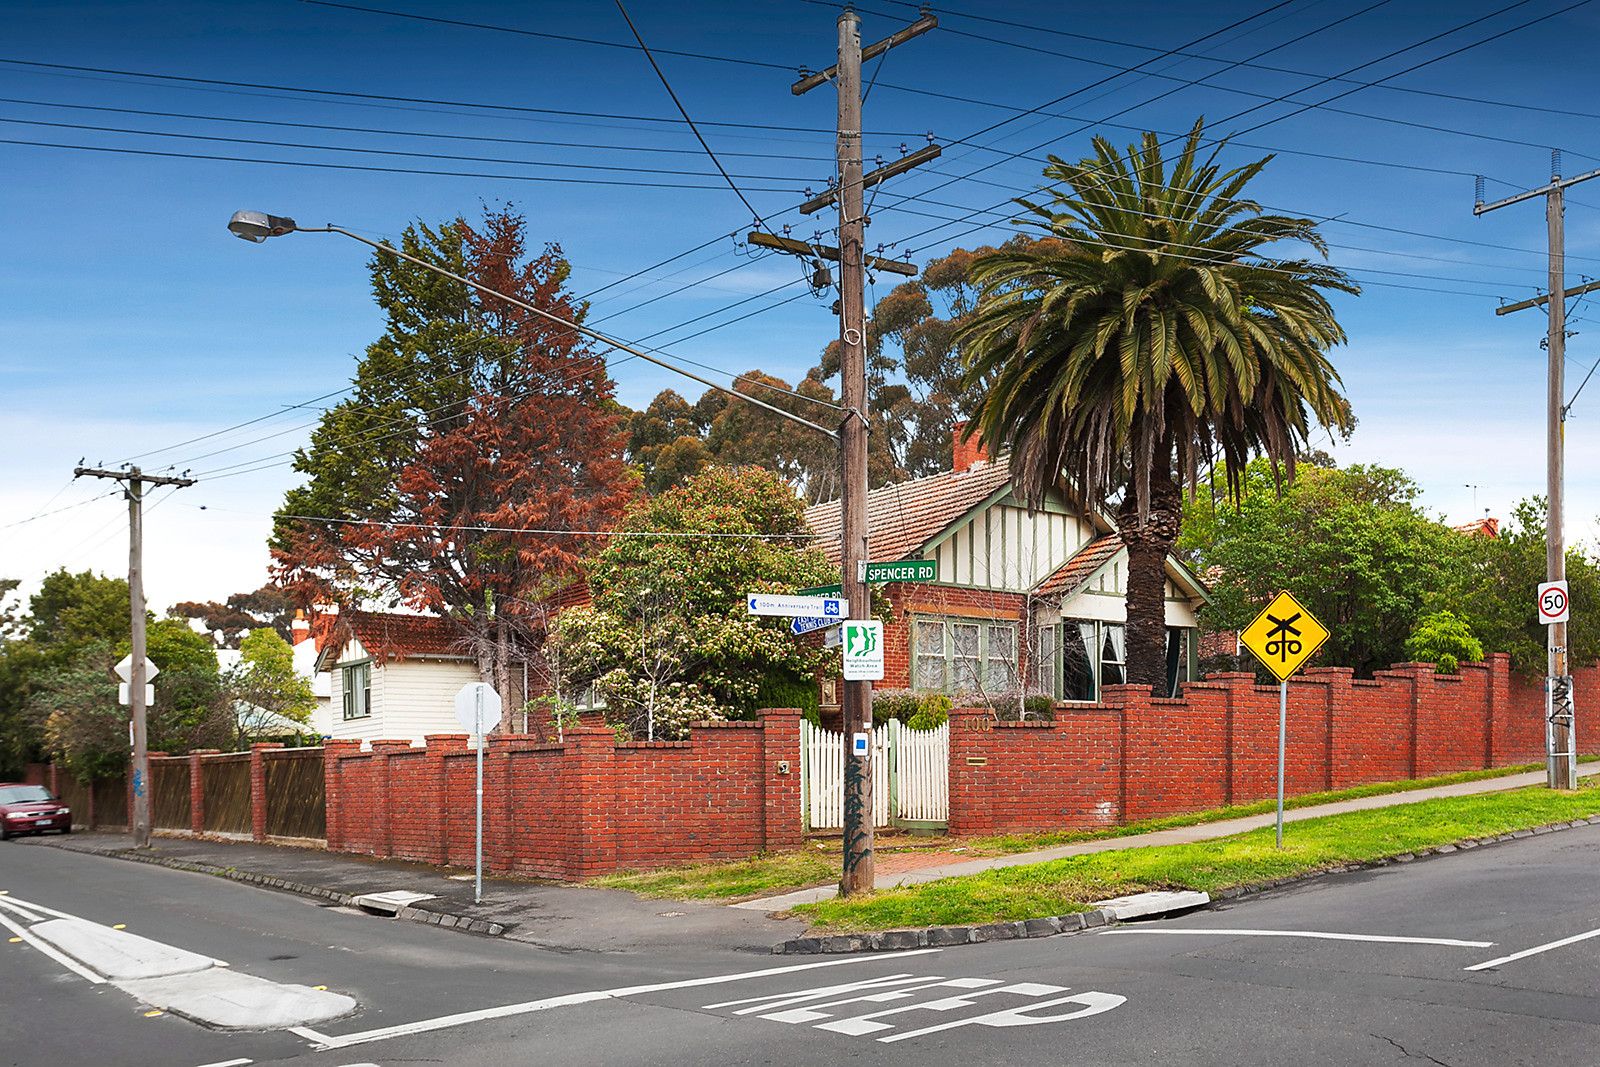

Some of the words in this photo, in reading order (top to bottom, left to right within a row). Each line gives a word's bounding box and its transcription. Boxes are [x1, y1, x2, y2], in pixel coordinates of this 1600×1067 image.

[868, 567, 915, 581] SPENCER
[918, 566, 934, 579] RD
[1544, 594, 1564, 611] 50
[963, 716, 990, 732] 100
[701, 973, 1128, 1043] KEEP
